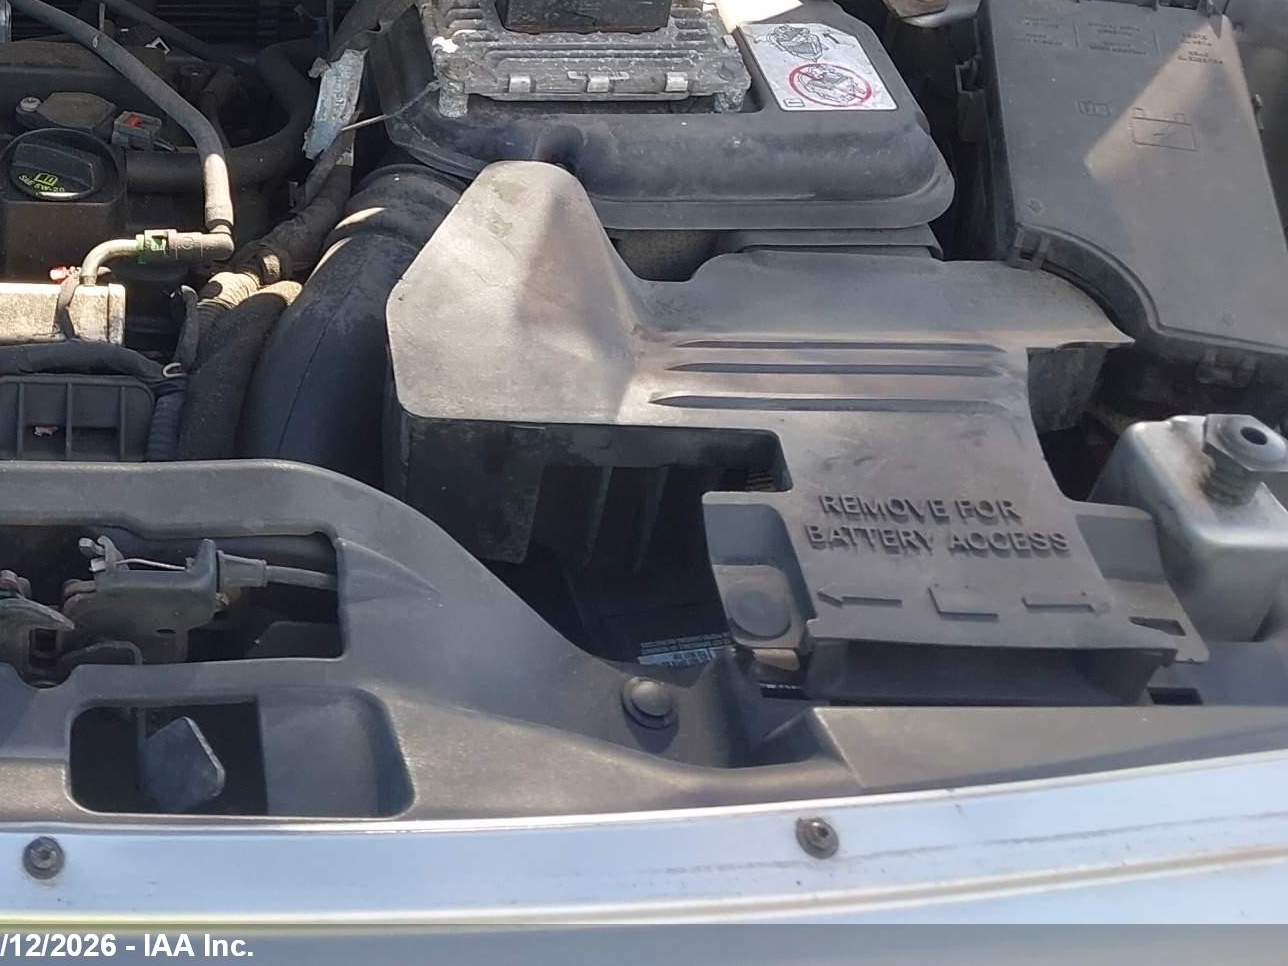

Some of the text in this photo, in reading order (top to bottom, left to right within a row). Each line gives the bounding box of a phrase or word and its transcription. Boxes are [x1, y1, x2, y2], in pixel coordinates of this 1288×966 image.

[819, 494, 1023, 527] REMOVE FOR
[806, 525, 1072, 558] BATTERY ACCESS
